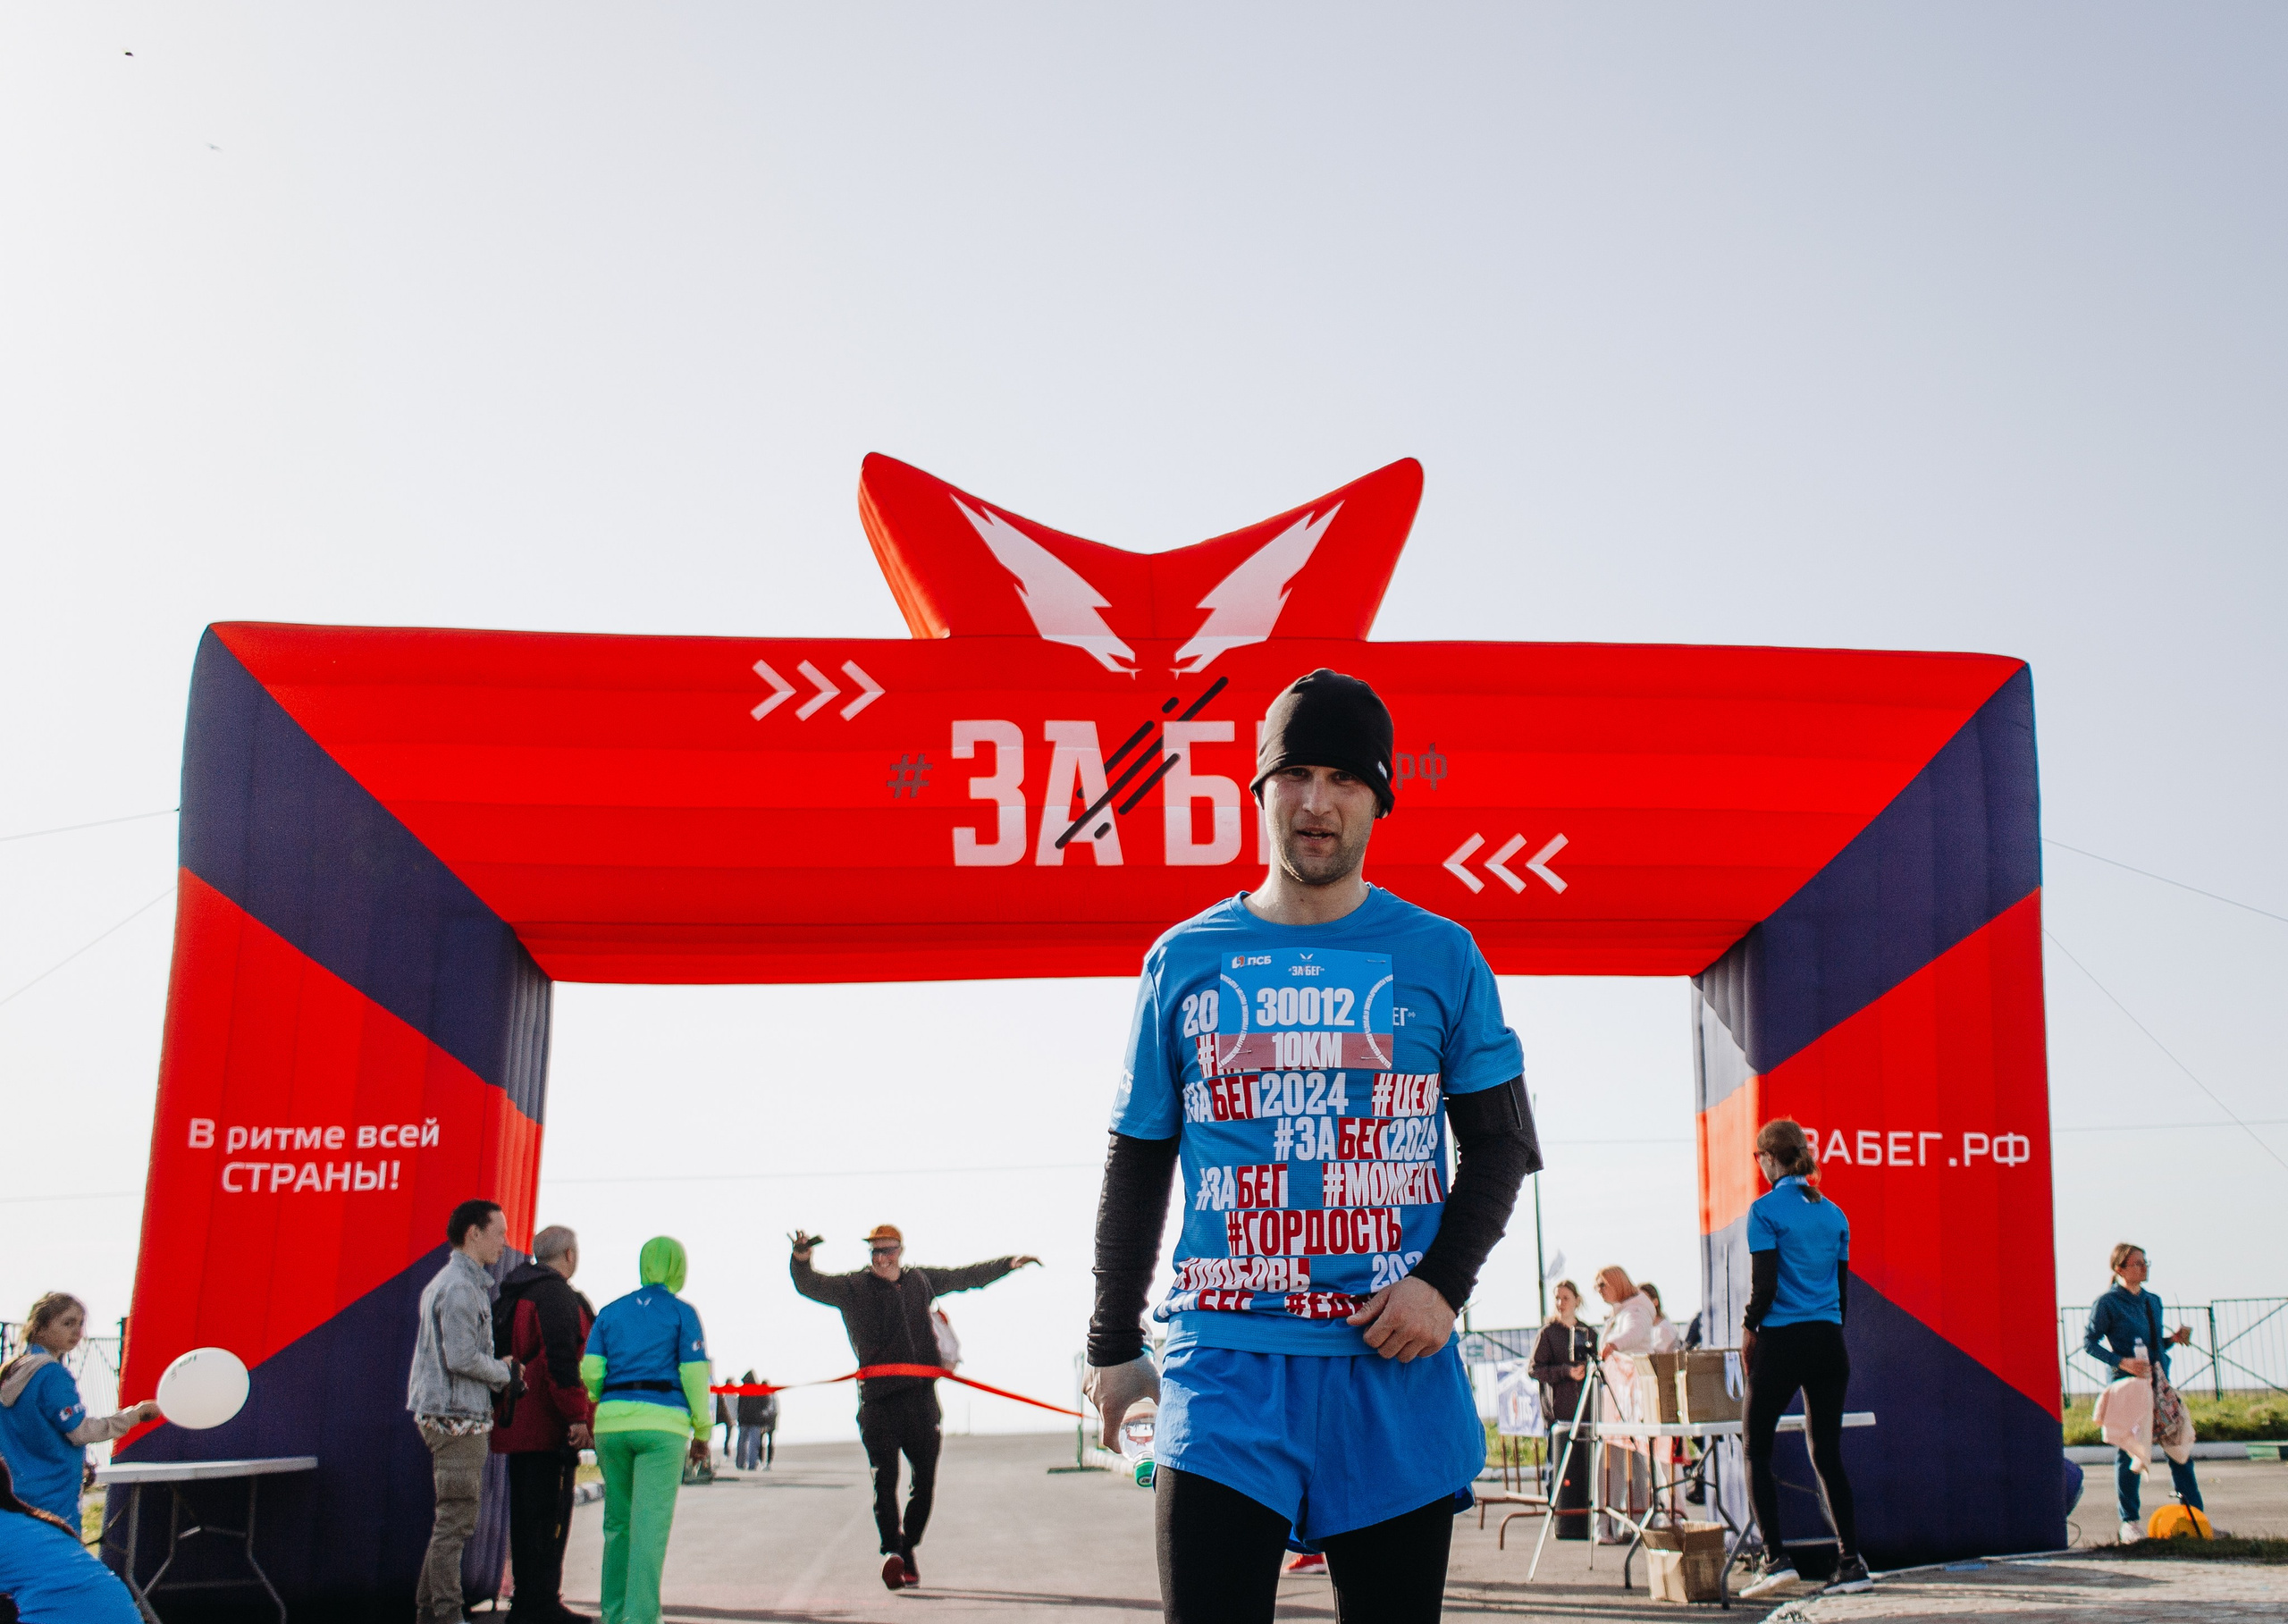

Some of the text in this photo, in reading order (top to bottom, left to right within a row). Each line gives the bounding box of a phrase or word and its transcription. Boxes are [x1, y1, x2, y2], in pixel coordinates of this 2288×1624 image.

[1247, 955, 1272, 966] ПСБ
[1182, 989, 1219, 1038] 20
[1256, 987, 1355, 1027] 30012
[188, 1117, 441, 1155] В ритме всей
[223, 1160, 401, 1193] СТРАНЫ!
[1227, 1209, 1402, 1257] #ГОРДОСТЬ
